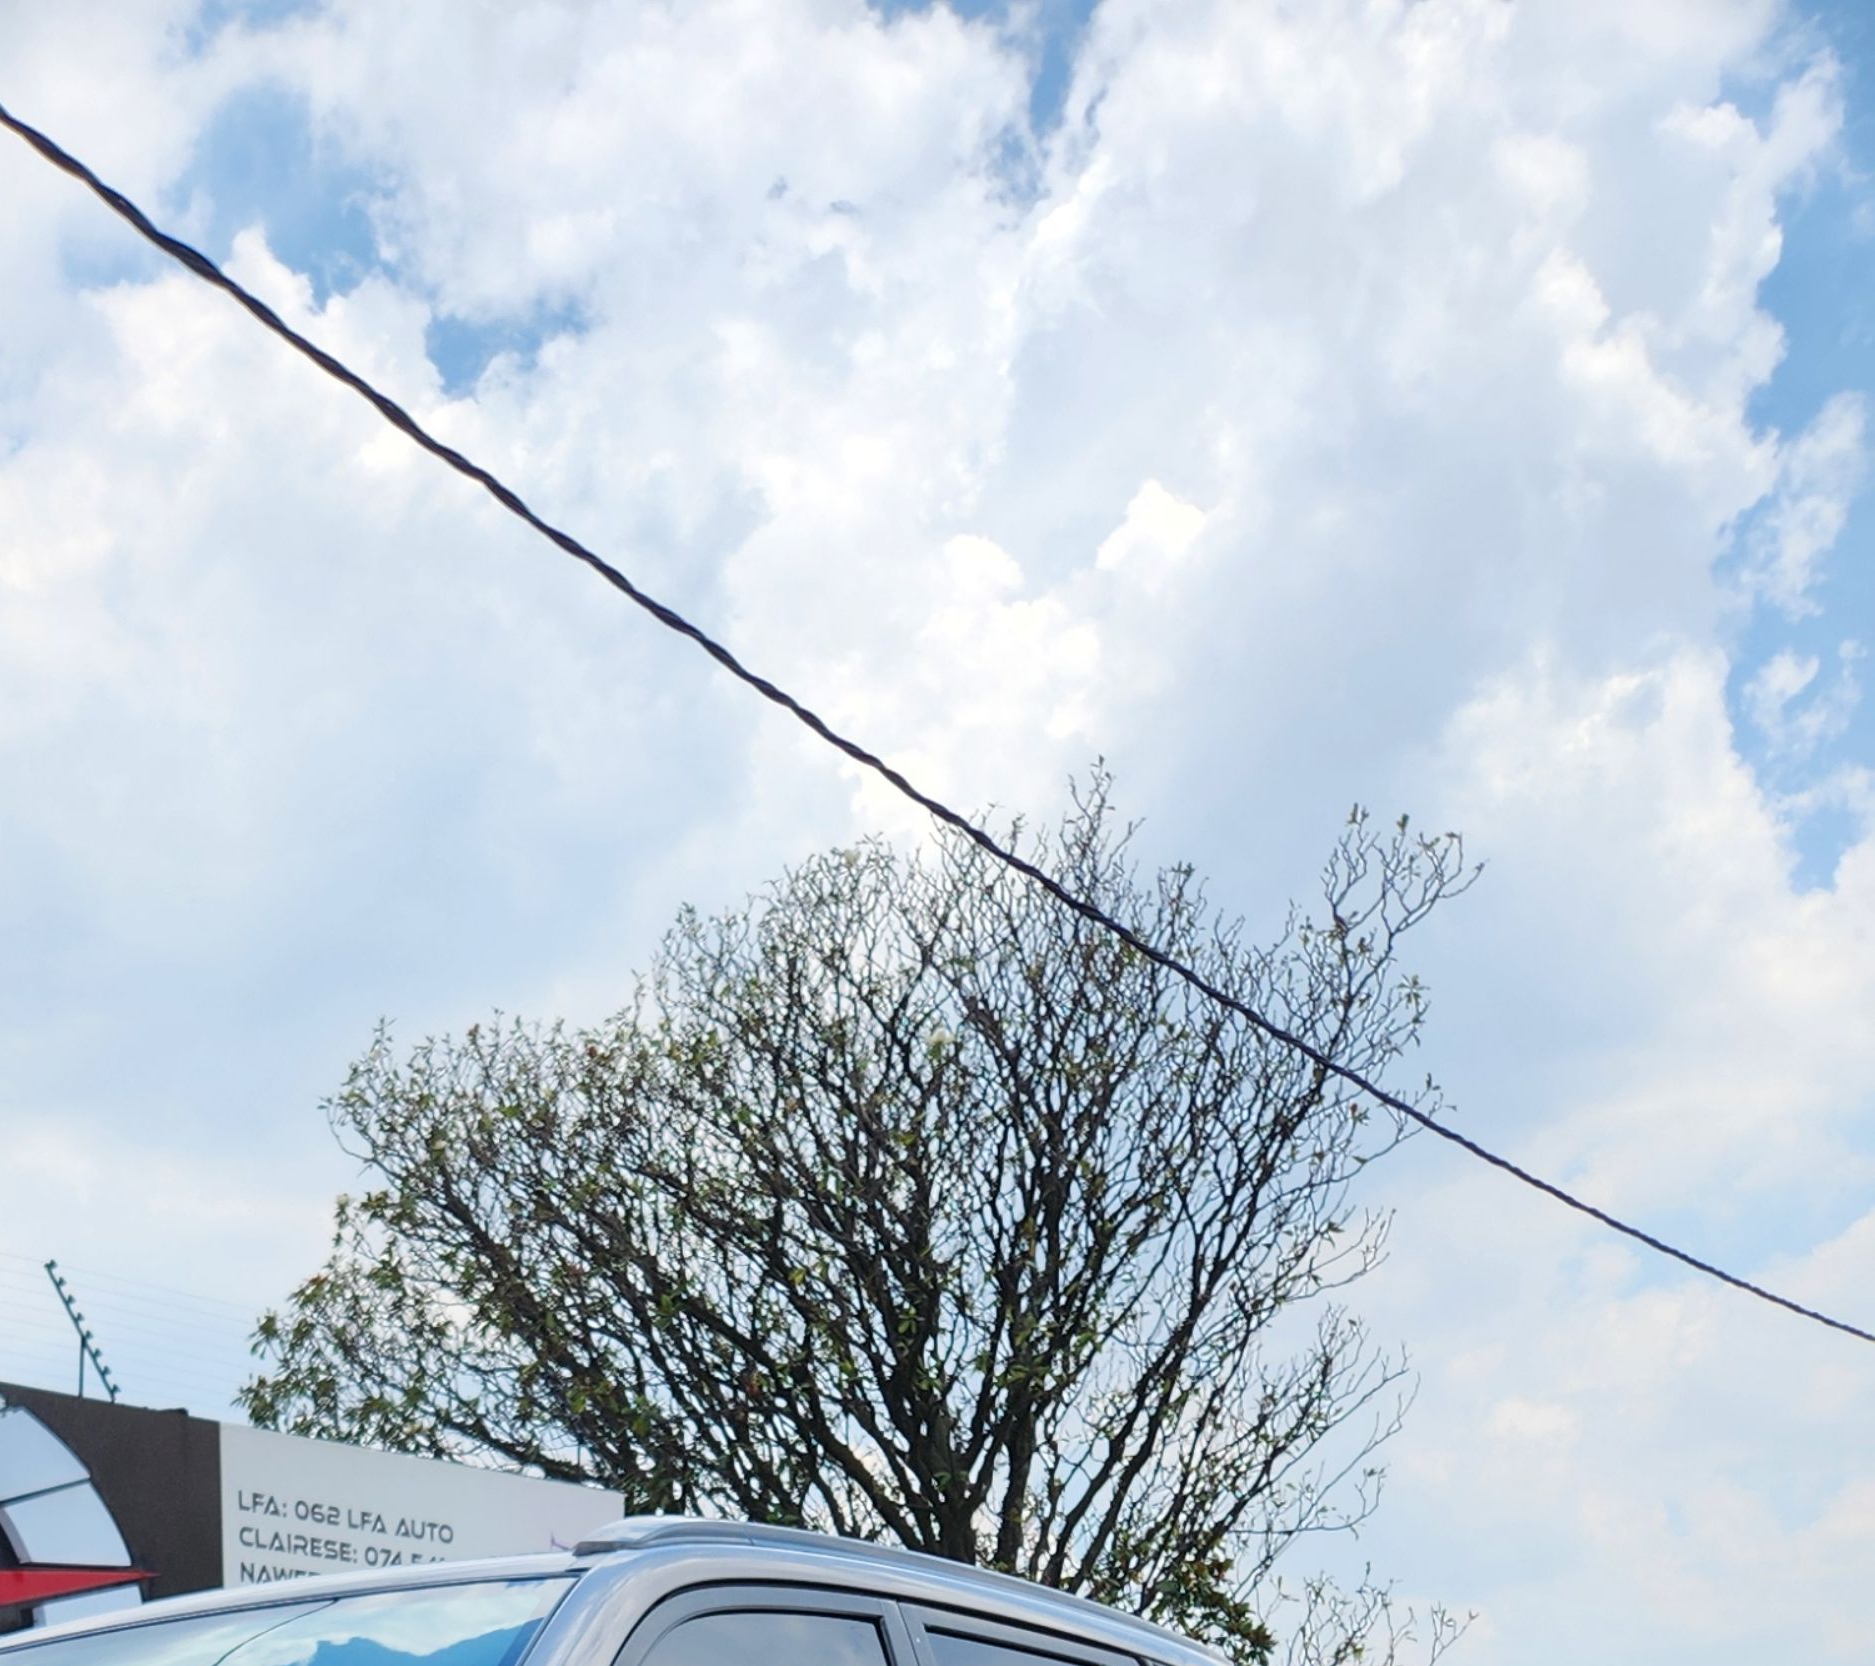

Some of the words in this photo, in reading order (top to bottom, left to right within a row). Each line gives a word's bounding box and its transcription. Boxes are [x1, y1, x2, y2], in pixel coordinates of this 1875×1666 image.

[238, 1490, 287, 1518] LFA:
[294, 1500, 340, 1526] 062
[347, 1509, 387, 1534] LFA
[395, 1518, 454, 1544] AUTO
[239, 1526, 358, 1563] CLAIRESE:
